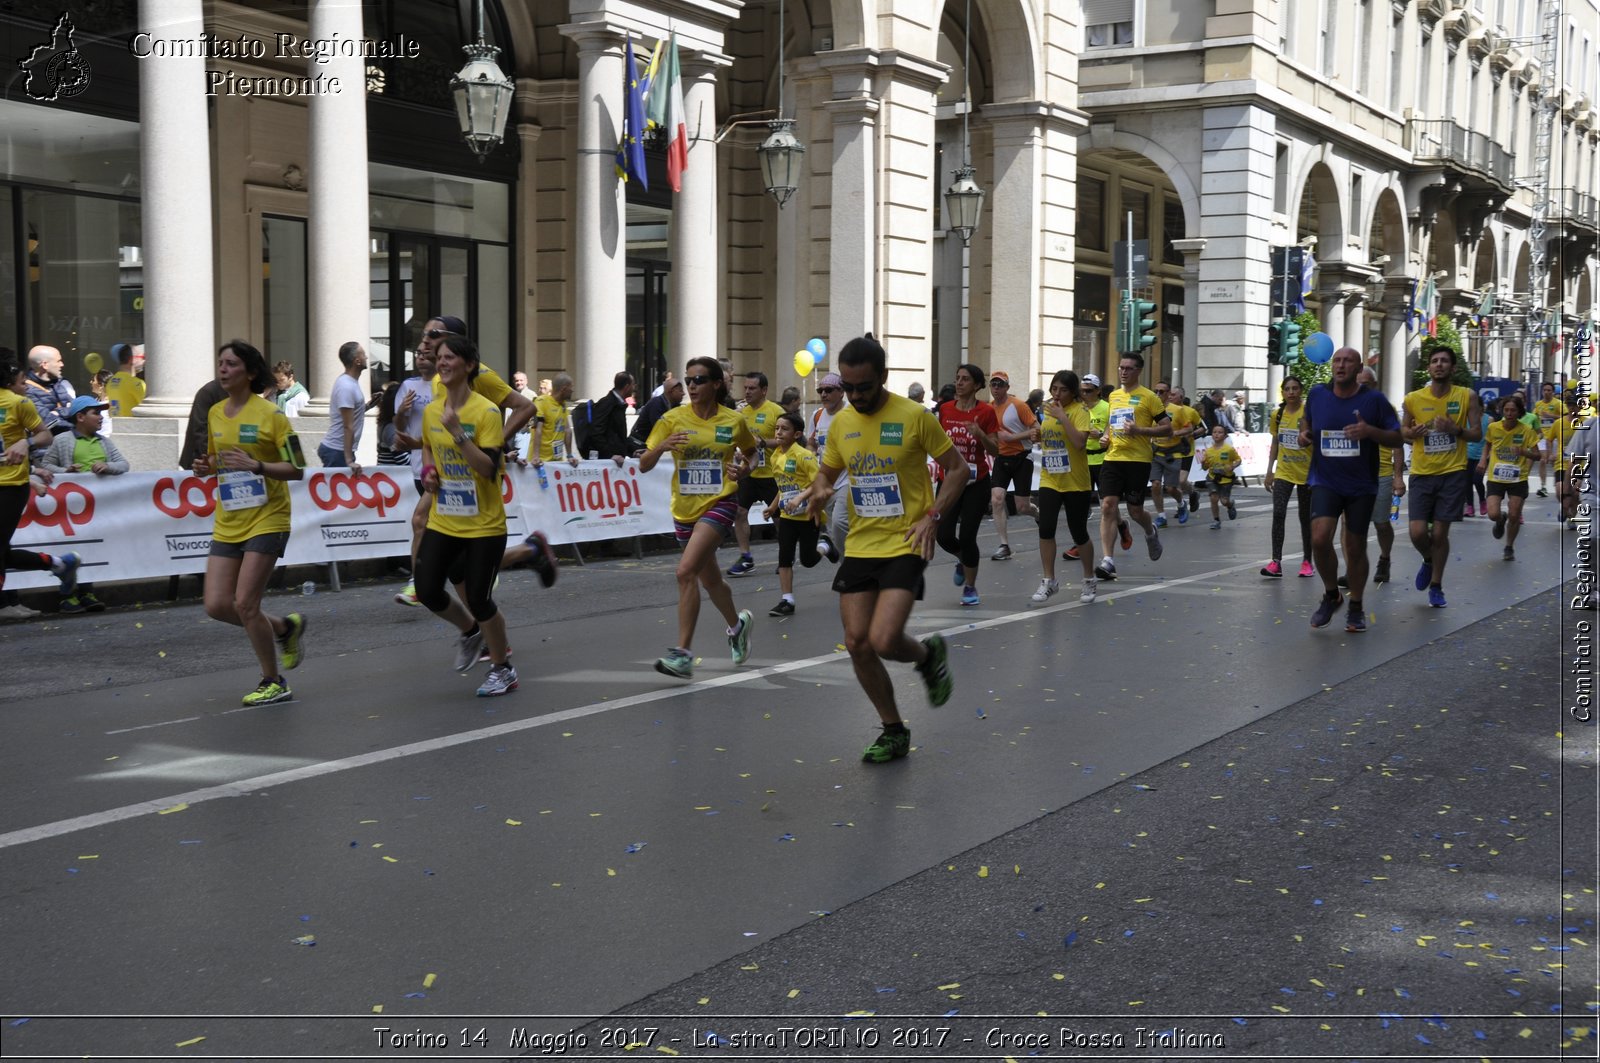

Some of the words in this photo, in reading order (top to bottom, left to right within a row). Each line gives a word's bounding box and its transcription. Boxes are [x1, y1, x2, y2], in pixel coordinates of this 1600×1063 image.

[1328, 439, 1352, 449] 10411
[1428, 434, 1450, 446] 6555
[1045, 456, 1063, 467] 5848
[563, 468, 600, 478] LATTERIE
[687, 470, 712, 484] 7078
[308, 472, 401, 518] coop
[554, 466, 642, 517] inalpi
[860, 492, 887, 506] 3588
[321, 529, 369, 540] Novacoop
